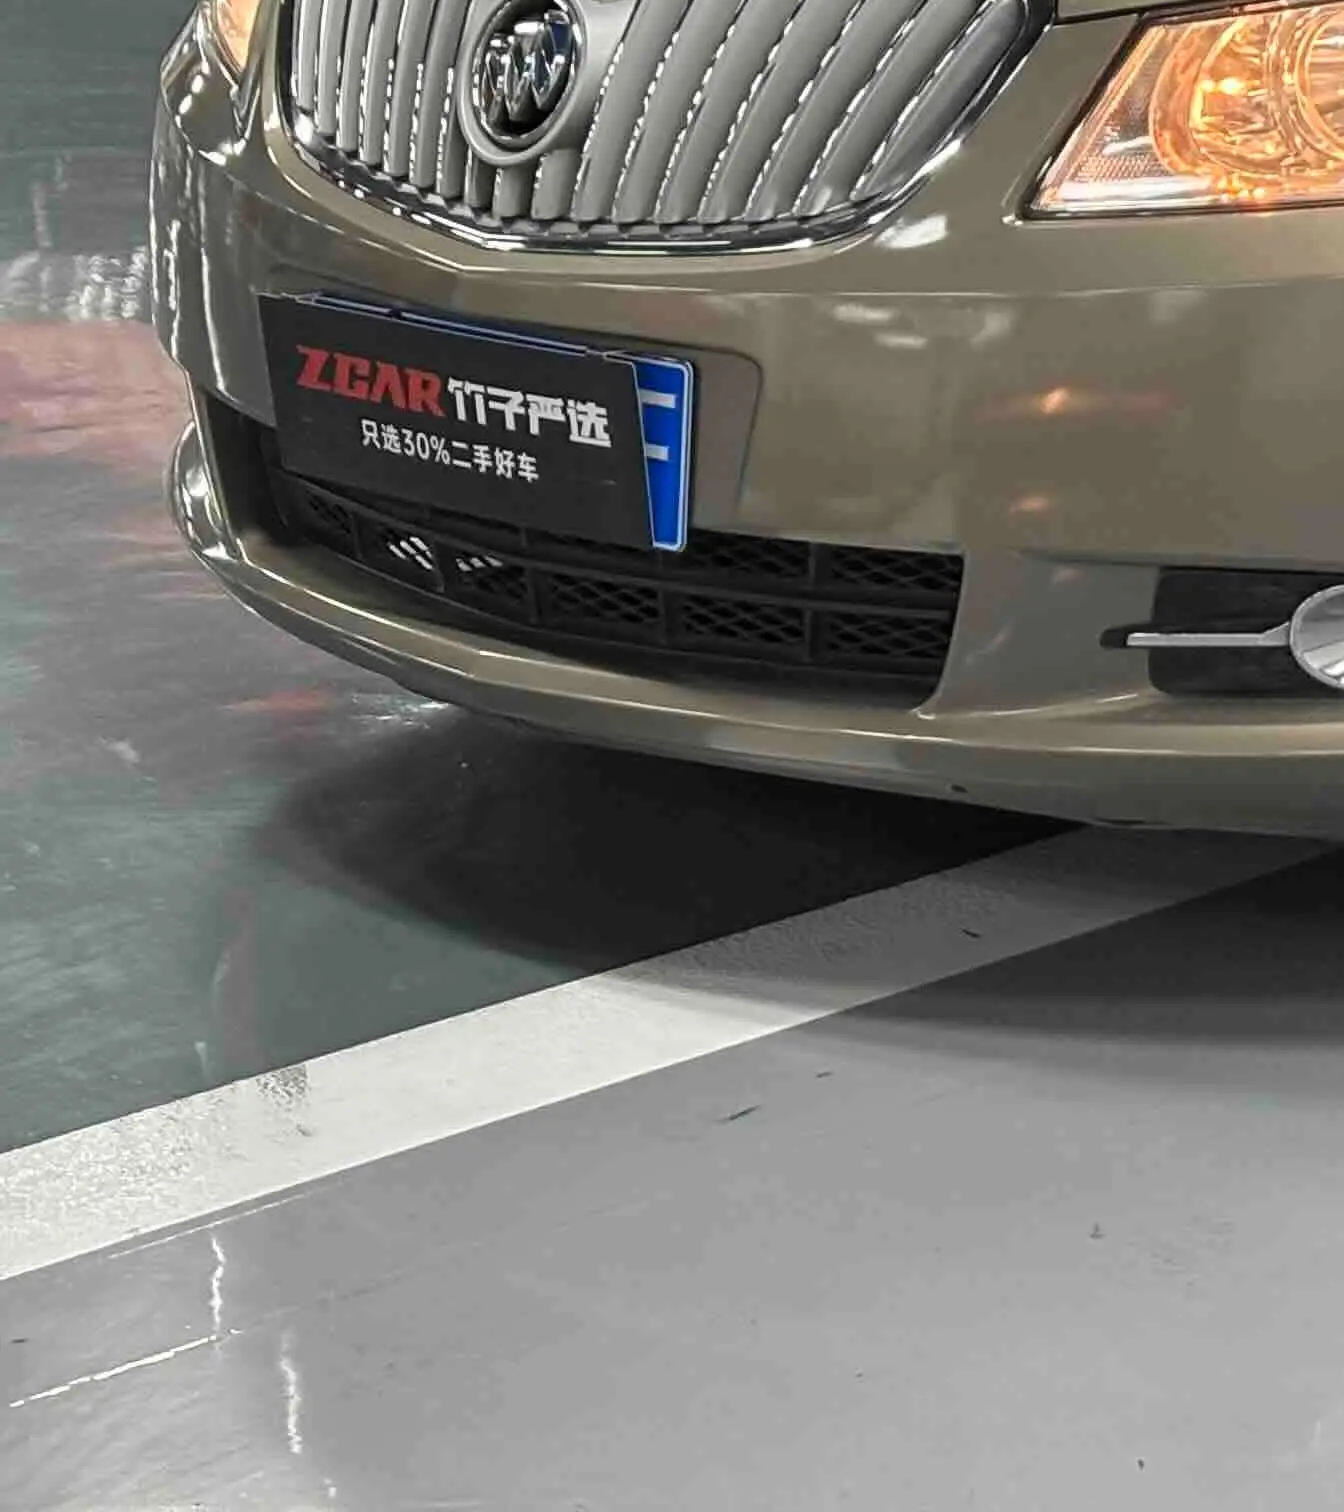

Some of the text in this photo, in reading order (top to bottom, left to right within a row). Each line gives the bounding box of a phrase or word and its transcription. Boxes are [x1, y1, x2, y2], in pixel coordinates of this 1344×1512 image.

[361, 418, 539, 483] 只选30%二手好车
